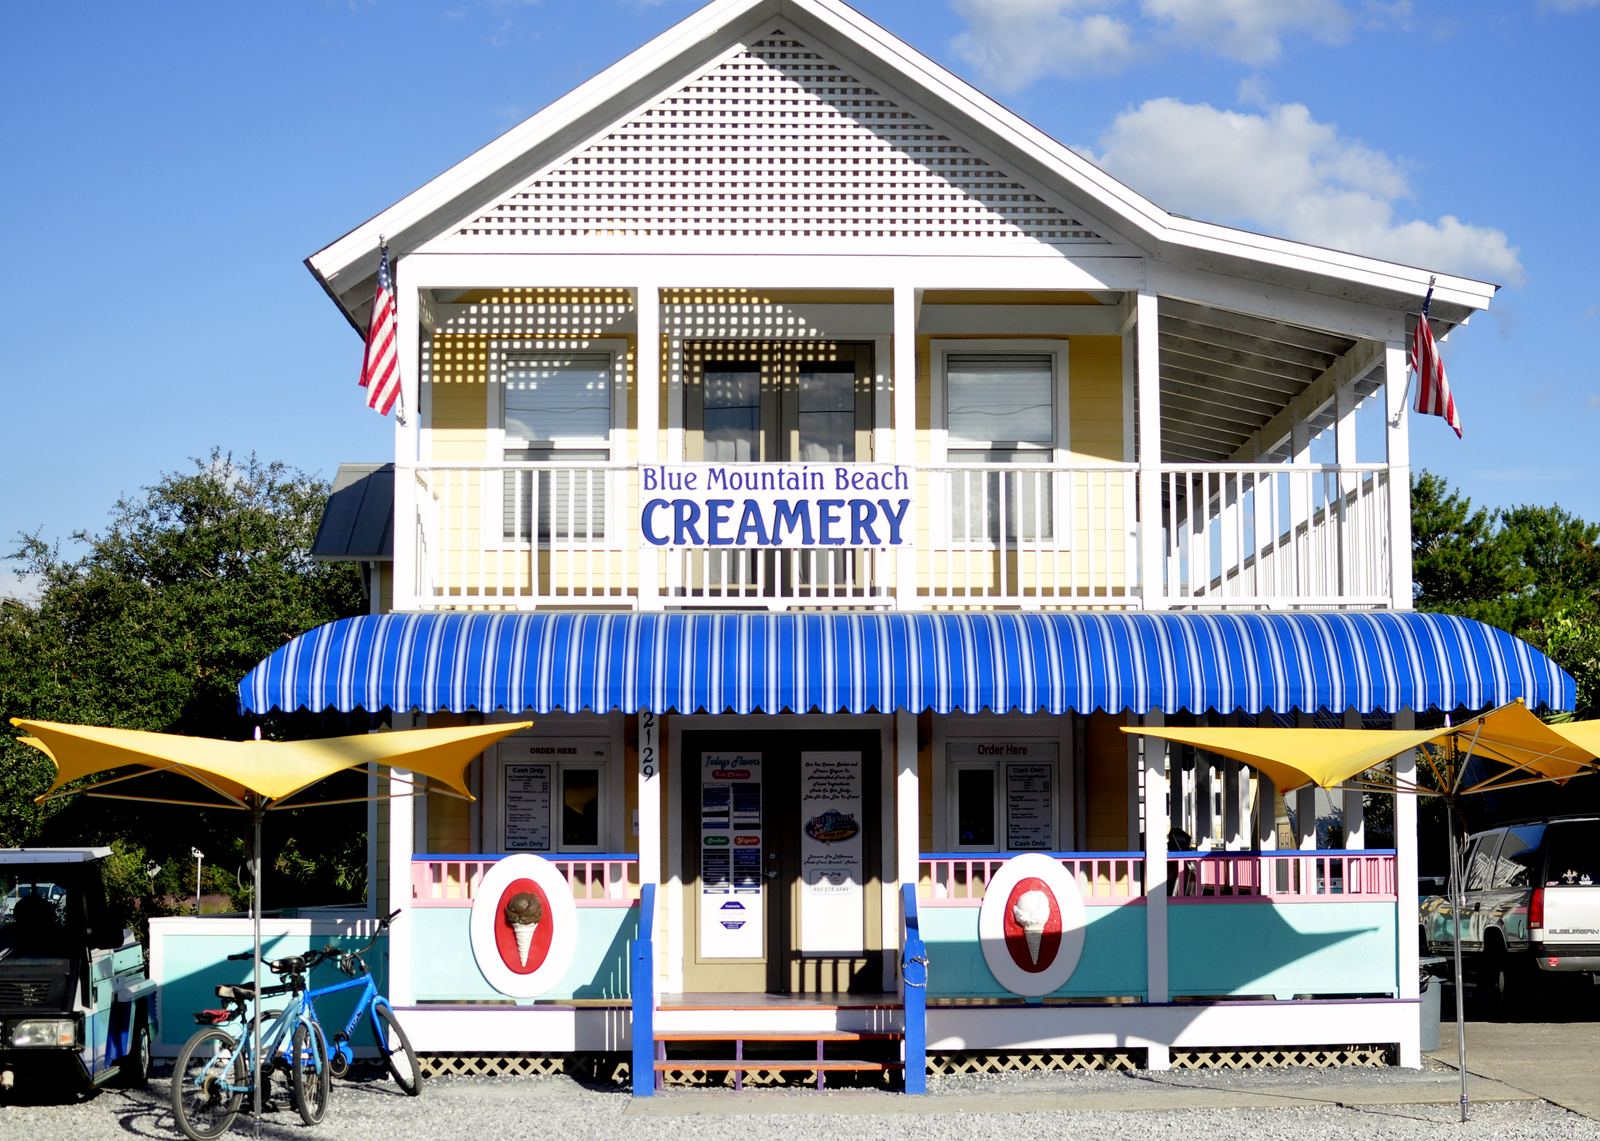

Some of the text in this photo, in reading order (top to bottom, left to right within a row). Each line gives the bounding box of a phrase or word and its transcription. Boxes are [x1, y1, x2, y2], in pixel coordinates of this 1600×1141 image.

[643, 466, 909, 490] Blue Mountain Beach
[641, 499, 910, 545] CREAMERY
[530, 747, 577, 755] ORDER HERE
[643, 711, 654, 782] 2129
[977, 744, 1028, 755] Order Here
